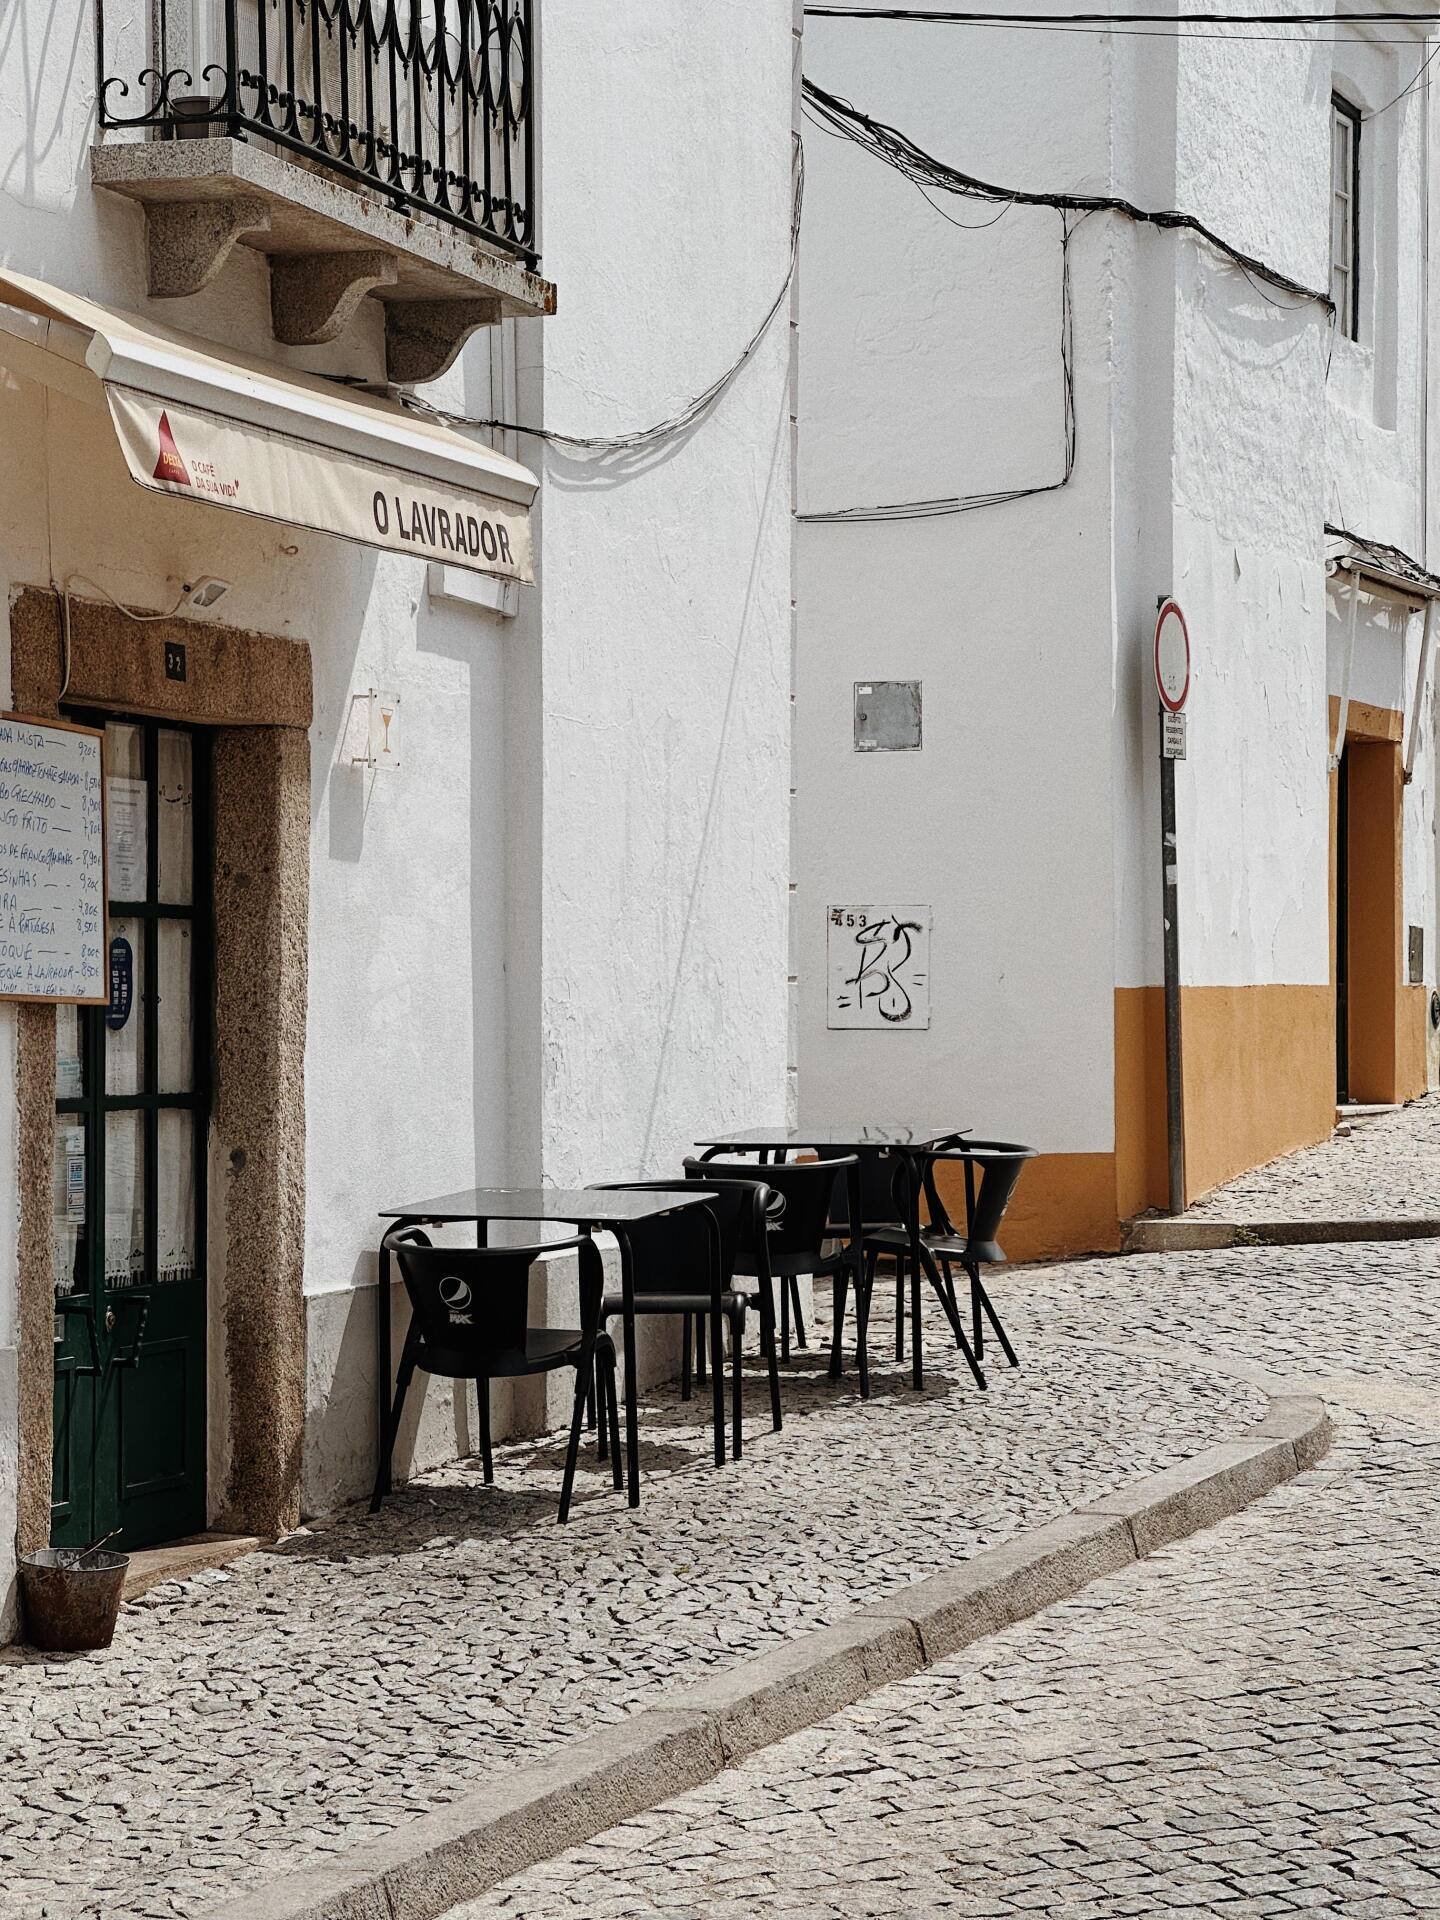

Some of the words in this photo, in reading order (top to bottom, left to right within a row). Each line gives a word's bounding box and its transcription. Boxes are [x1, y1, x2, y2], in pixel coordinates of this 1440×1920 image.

[192, 460, 198, 471] O
[198, 461, 215, 477] CAFÉ
[196, 476, 206, 489] DA
[206, 479, 219, 495] SUA
[220, 482, 237, 498] VIDA
[373, 490, 389, 535] O
[395, 496, 514, 565] LAVRADOR
